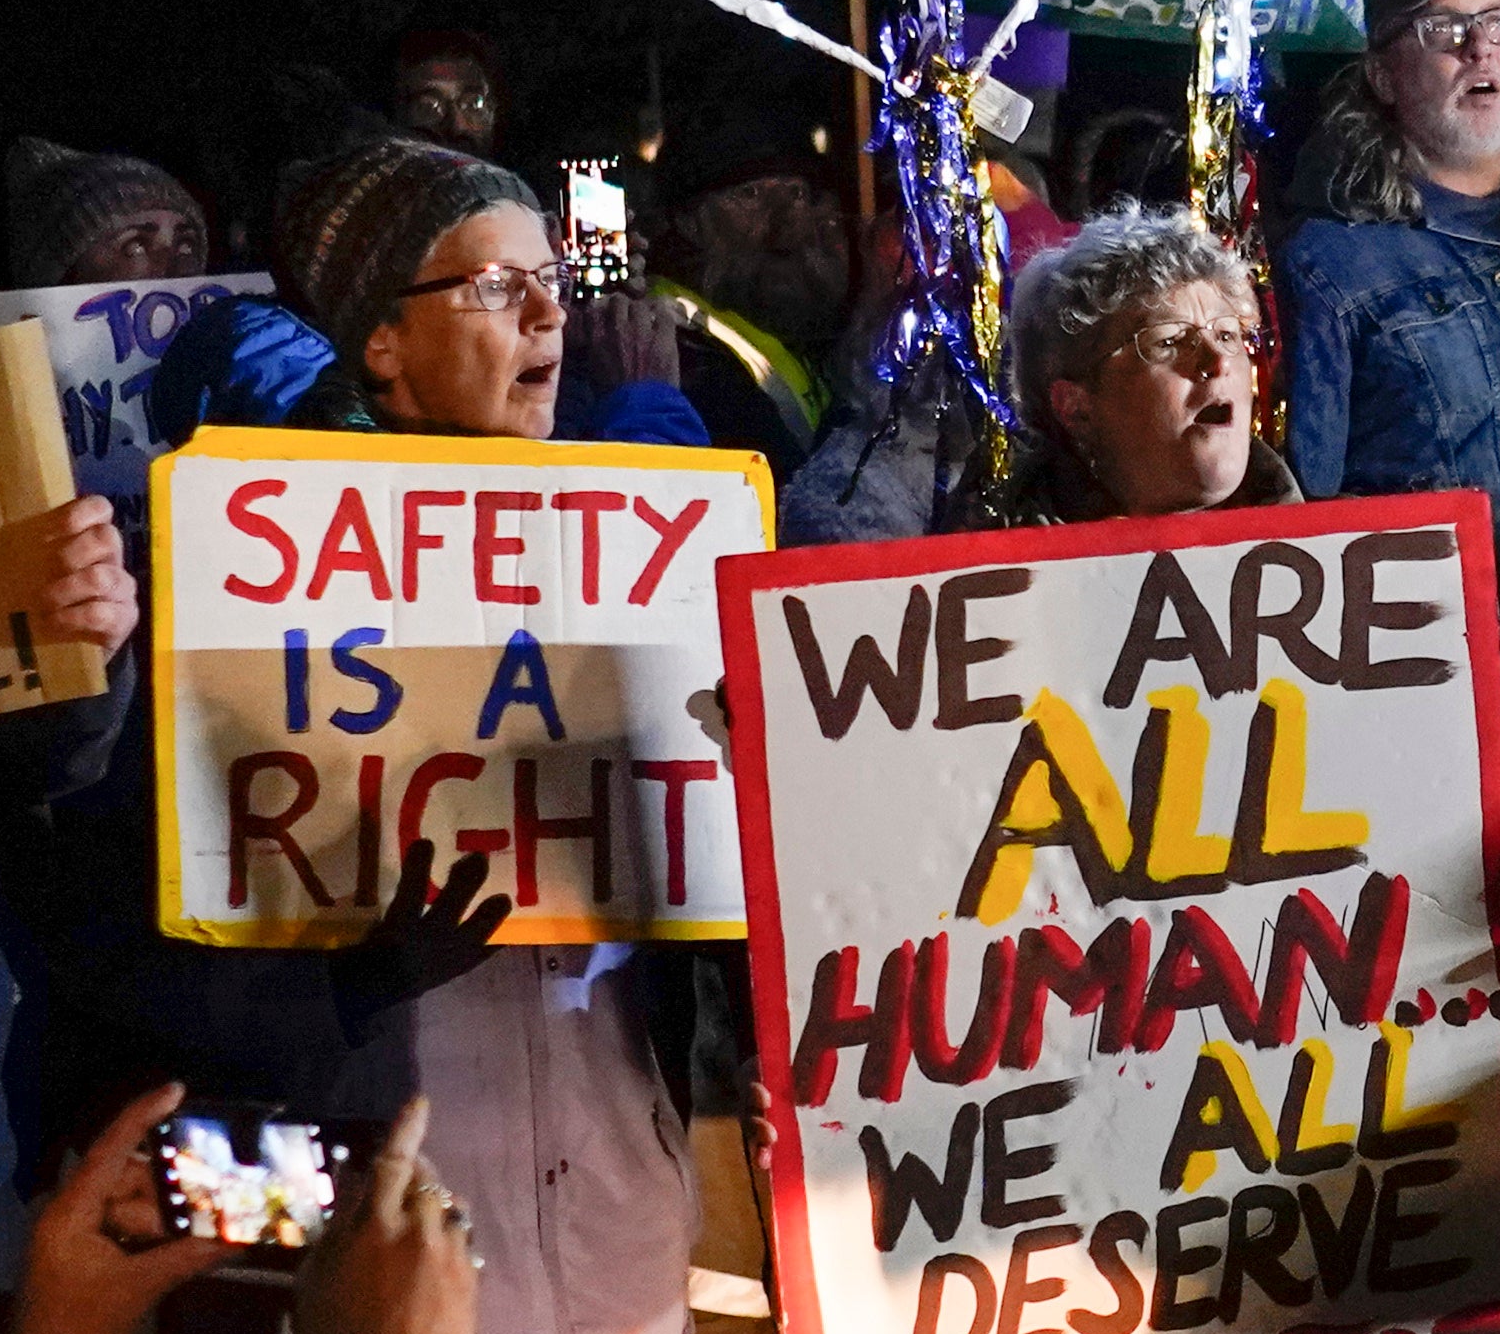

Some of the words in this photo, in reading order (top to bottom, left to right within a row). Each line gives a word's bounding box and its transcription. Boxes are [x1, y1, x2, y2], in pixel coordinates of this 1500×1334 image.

[223, 479, 710, 607] SAFETY
[782, 568, 1031, 740] WE
[1103, 529, 1460, 711] ARE
[283, 628, 404, 734] IS
[477, 629, 566, 741] A
[227, 751, 718, 910] RIGHT
[956, 677, 1369, 924] ALL
[859, 1077, 1079, 1253] WE
[1160, 1020, 1460, 1193] ALL
